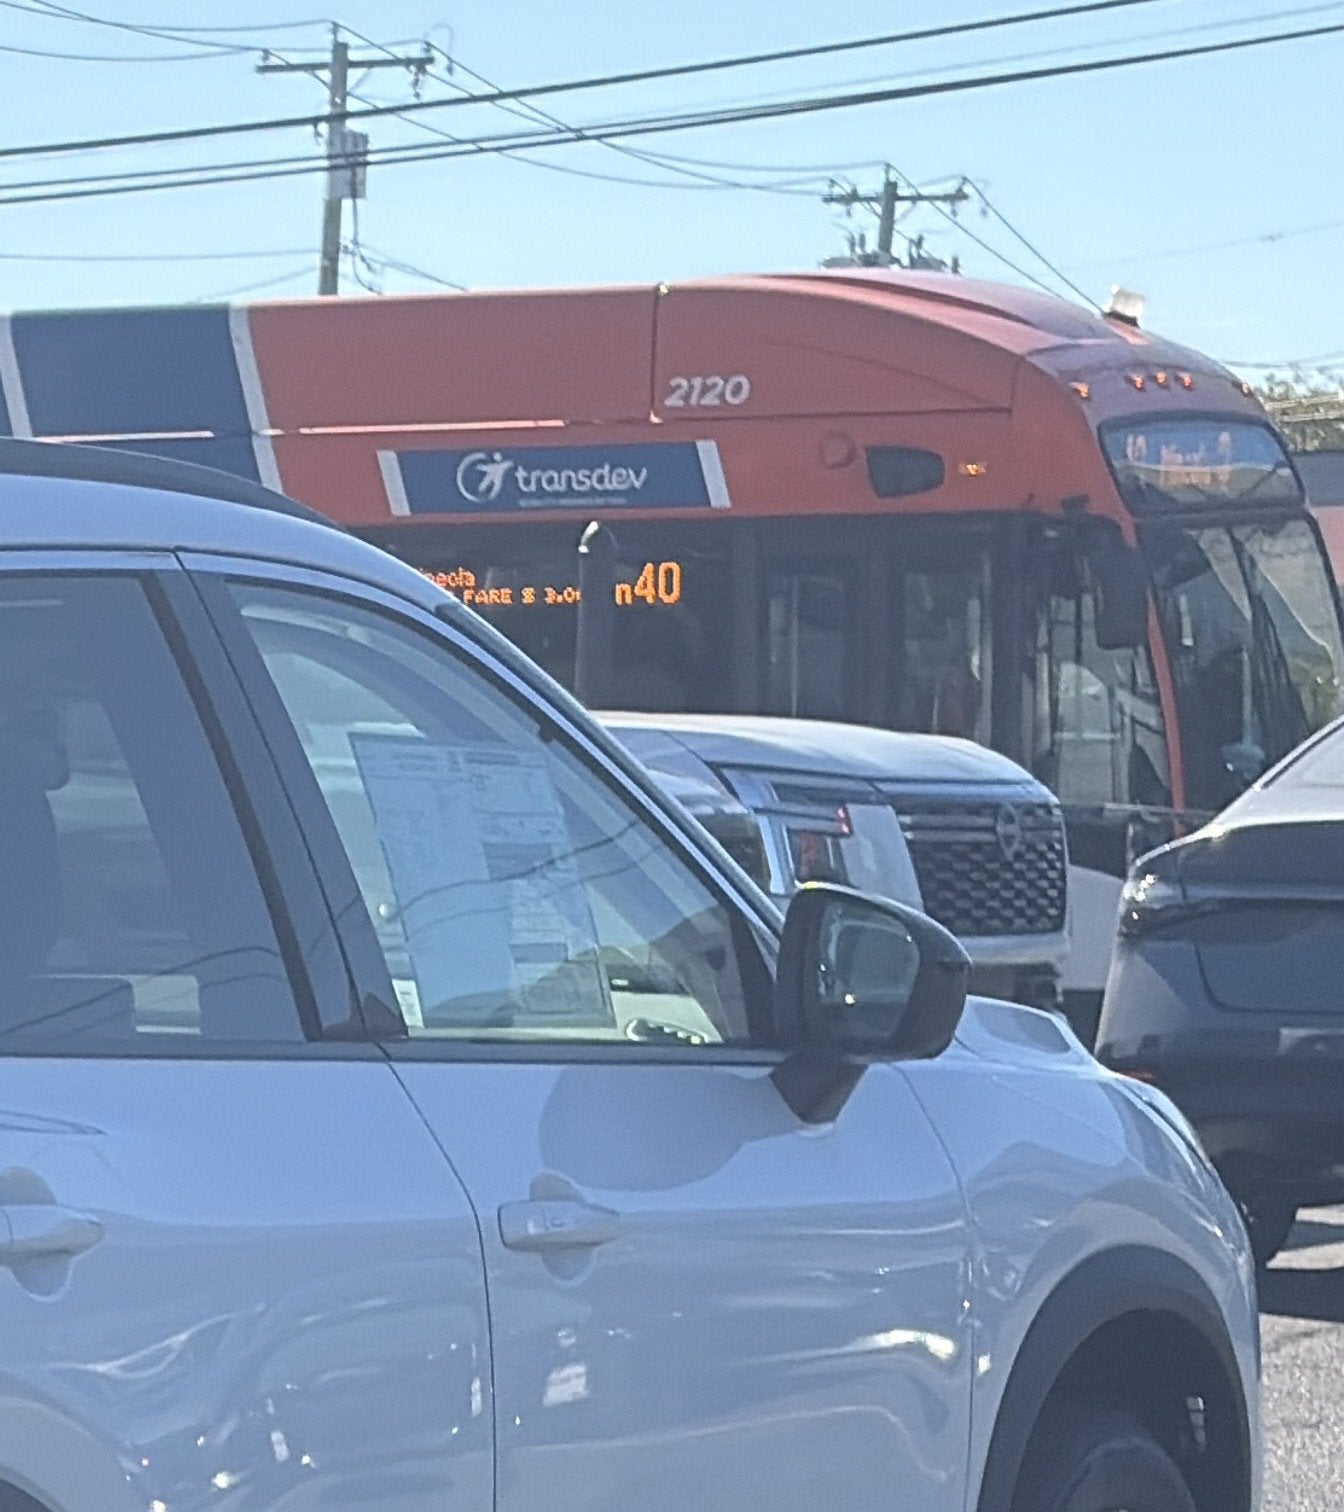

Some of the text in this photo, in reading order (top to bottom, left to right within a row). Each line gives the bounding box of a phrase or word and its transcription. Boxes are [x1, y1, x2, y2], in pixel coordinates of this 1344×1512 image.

[664, 375, 751, 408] 2120
[515, 462, 648, 492] transdev
[462, 588, 513, 605] FARE
[615, 561, 682, 605] n40
